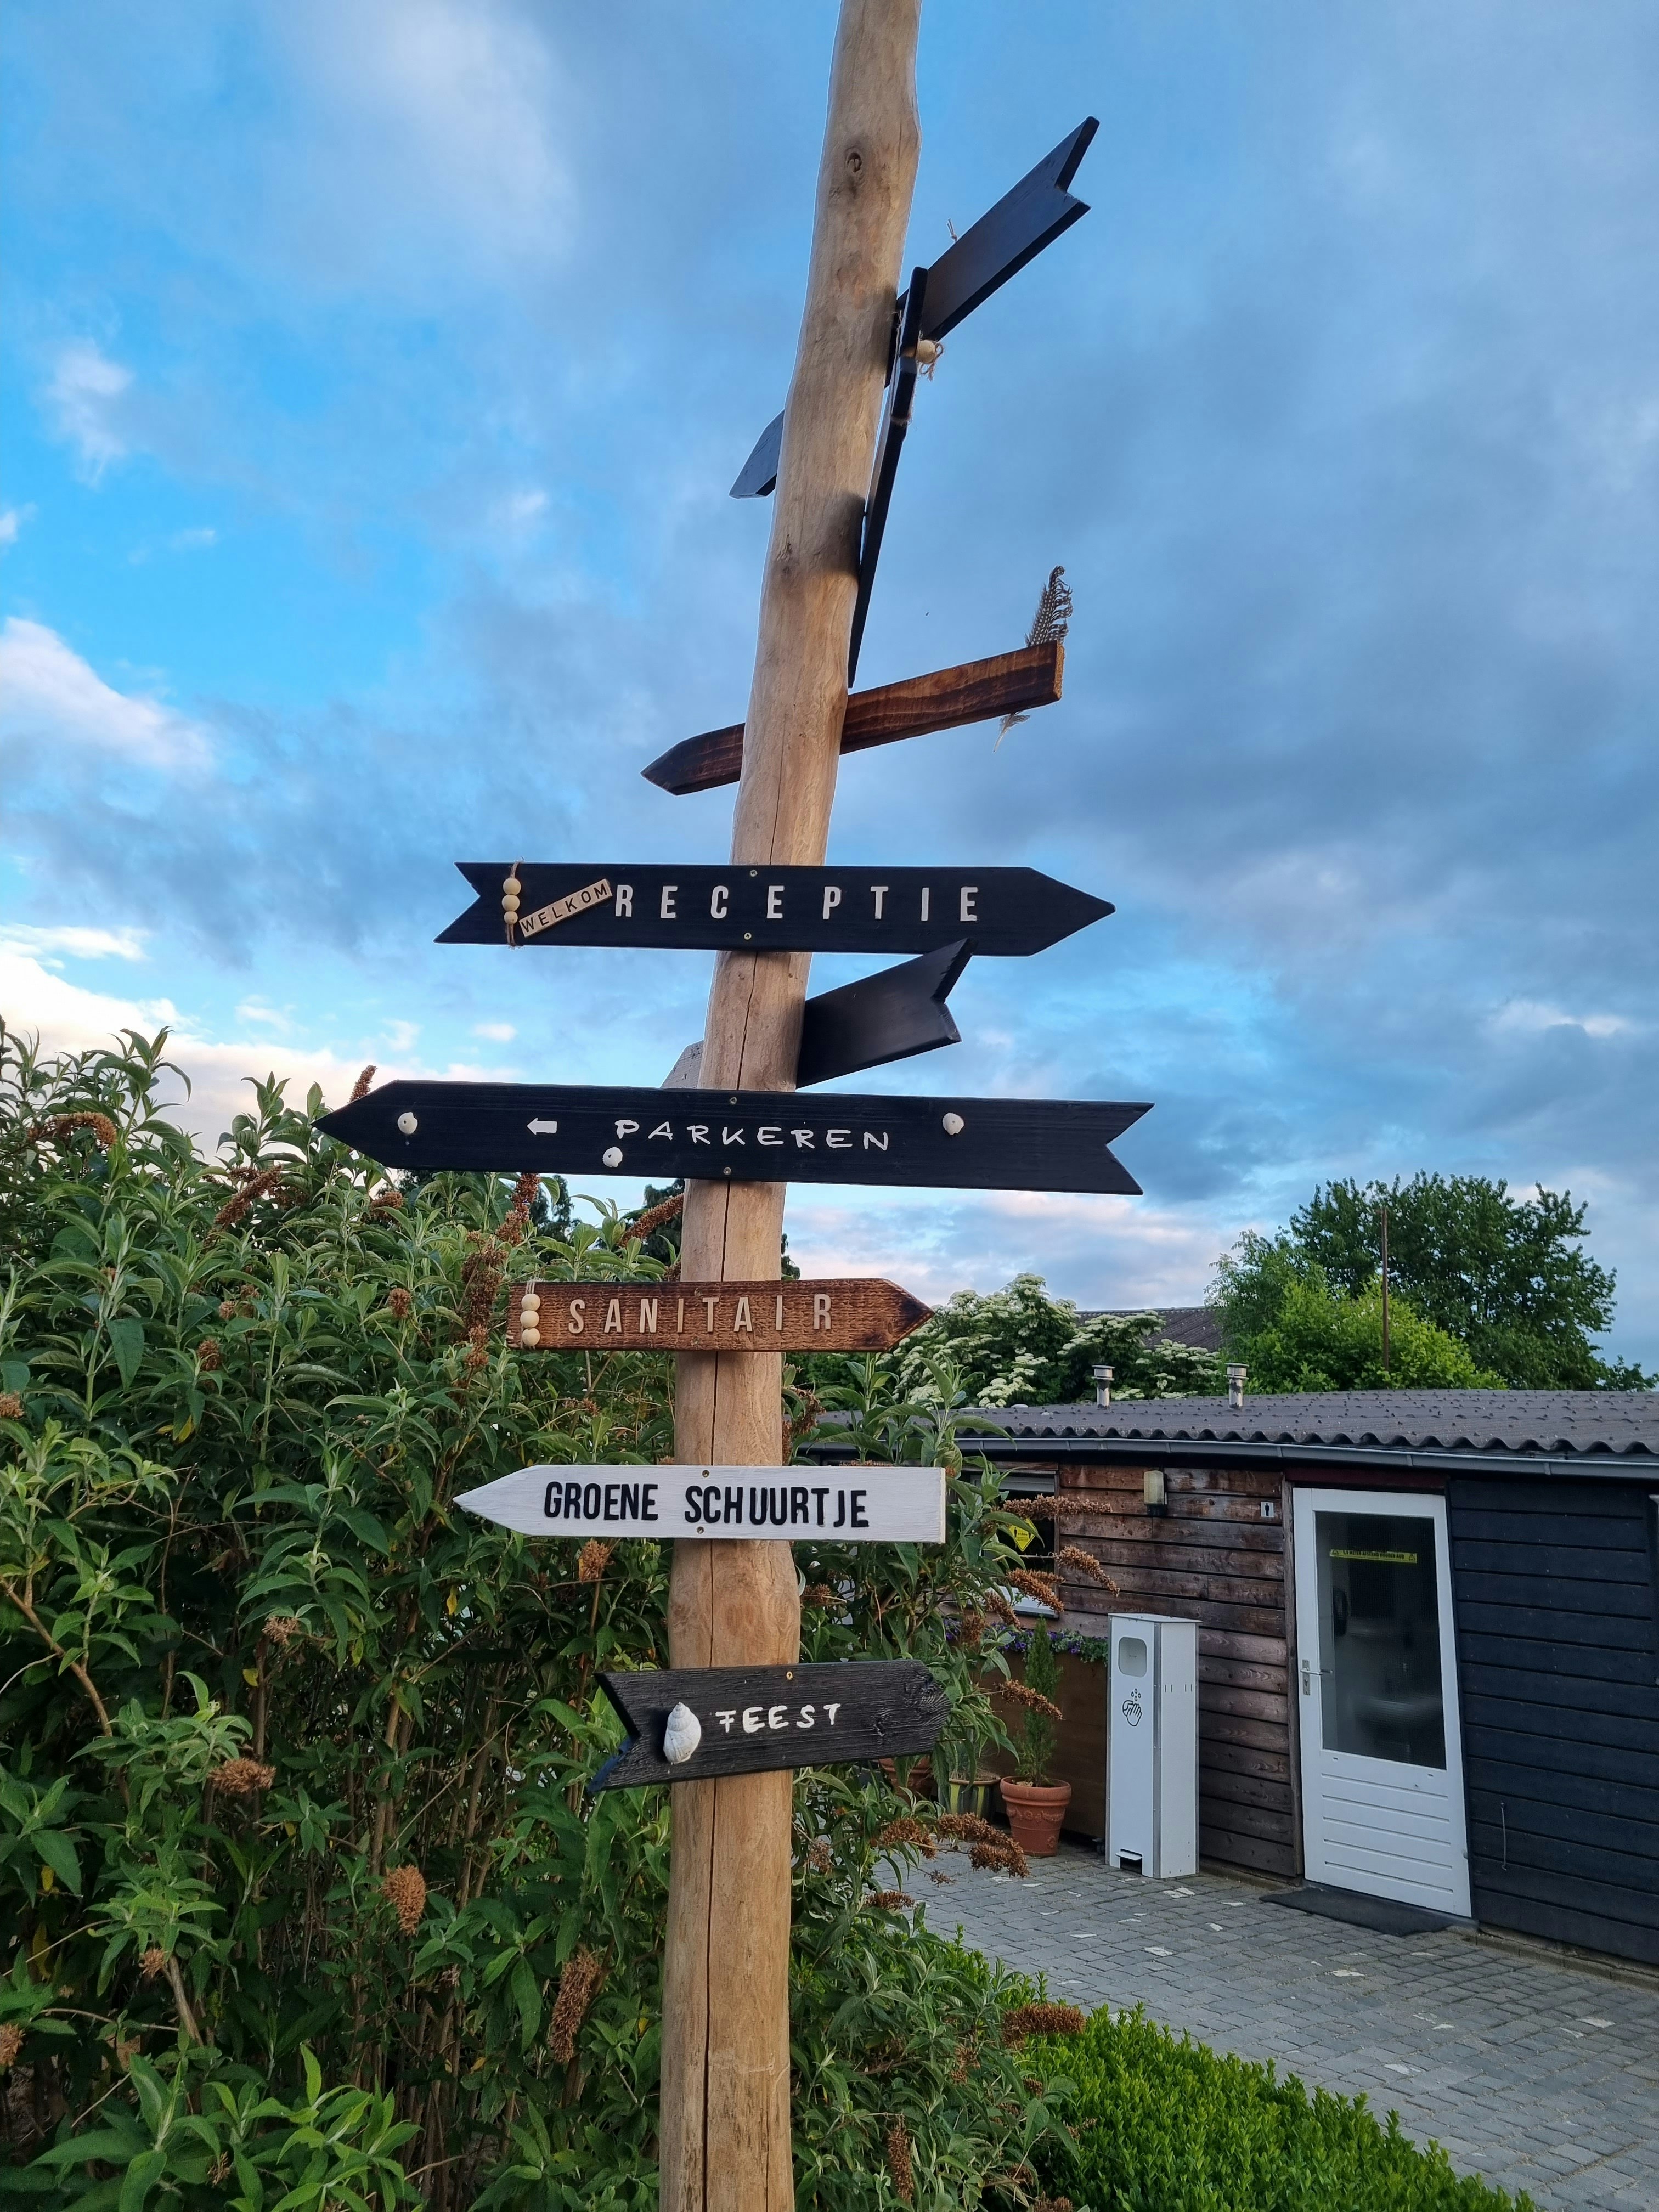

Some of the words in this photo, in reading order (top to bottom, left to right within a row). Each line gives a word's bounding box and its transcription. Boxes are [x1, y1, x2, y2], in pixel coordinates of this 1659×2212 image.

[521, 883, 607, 933] WELKOM
[614, 884, 979, 922] RECEPTIE
[614, 1119, 889, 1152] PARKEREN
[568, 1293, 831, 1334] SANITAIR
[543, 1481, 659, 1521] GROENE
[684, 1485, 870, 1528] SCHUURTJE
[714, 1702, 842, 1734] FEEST
